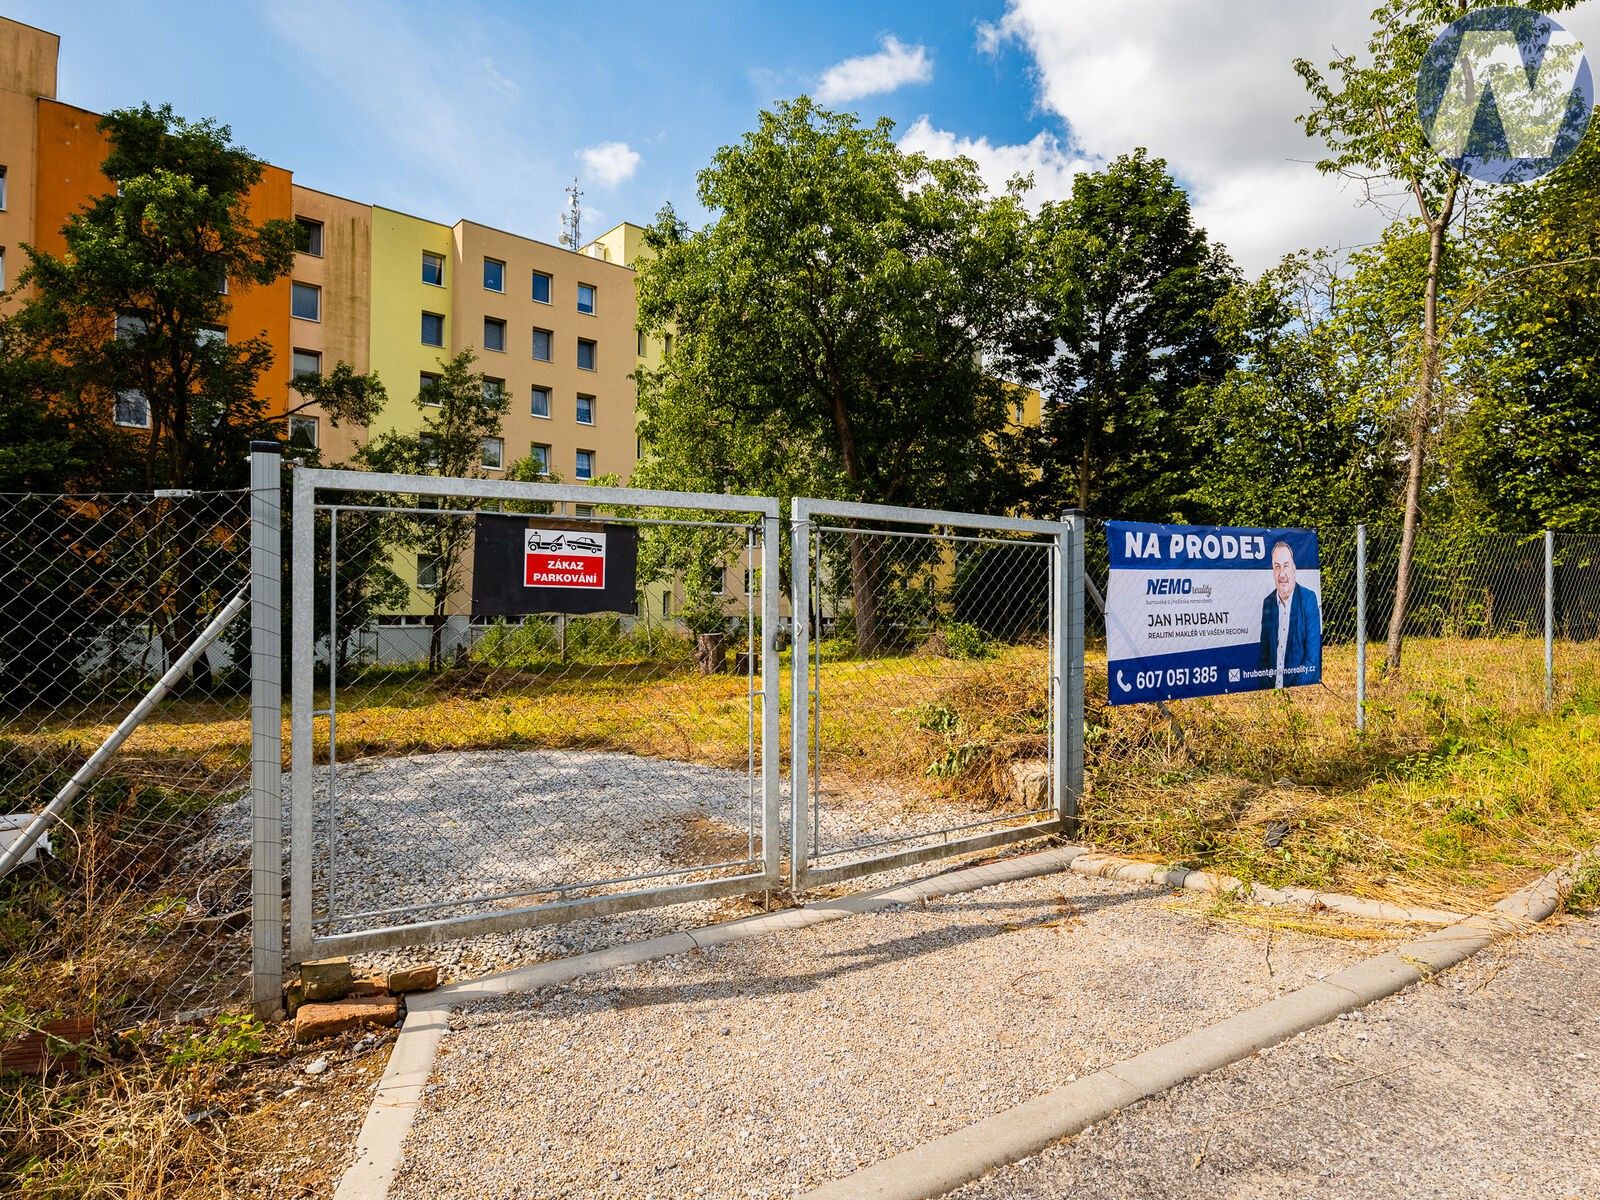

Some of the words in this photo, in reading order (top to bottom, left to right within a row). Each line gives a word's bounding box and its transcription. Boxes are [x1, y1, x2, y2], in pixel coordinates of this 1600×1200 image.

[1125, 531, 1161, 559] NA
[1169, 534, 1266, 560] PRODEJ
[547, 558, 584, 570] ZÁKAZ
[533, 572, 597, 583] PARKOVÁNÍ
[1146, 578, 1192, 595] NEMO
[1192, 584, 1212, 597] reality
[1148, 613, 1172, 627] JAN
[1175, 612, 1229, 626] HRUBANT
[1148, 630, 1174, 639] REALITNÍ
[1175, 629, 1198, 638] MAKLÉŘ
[1207, 628, 1225, 636] VAŠEM
[1136, 670, 1163, 689] 607
[1167, 668, 1189, 686] 051
[1192, 666, 1218, 684] 385
[1243, 665, 1316, 679] hrubant@nmoreality.cz
